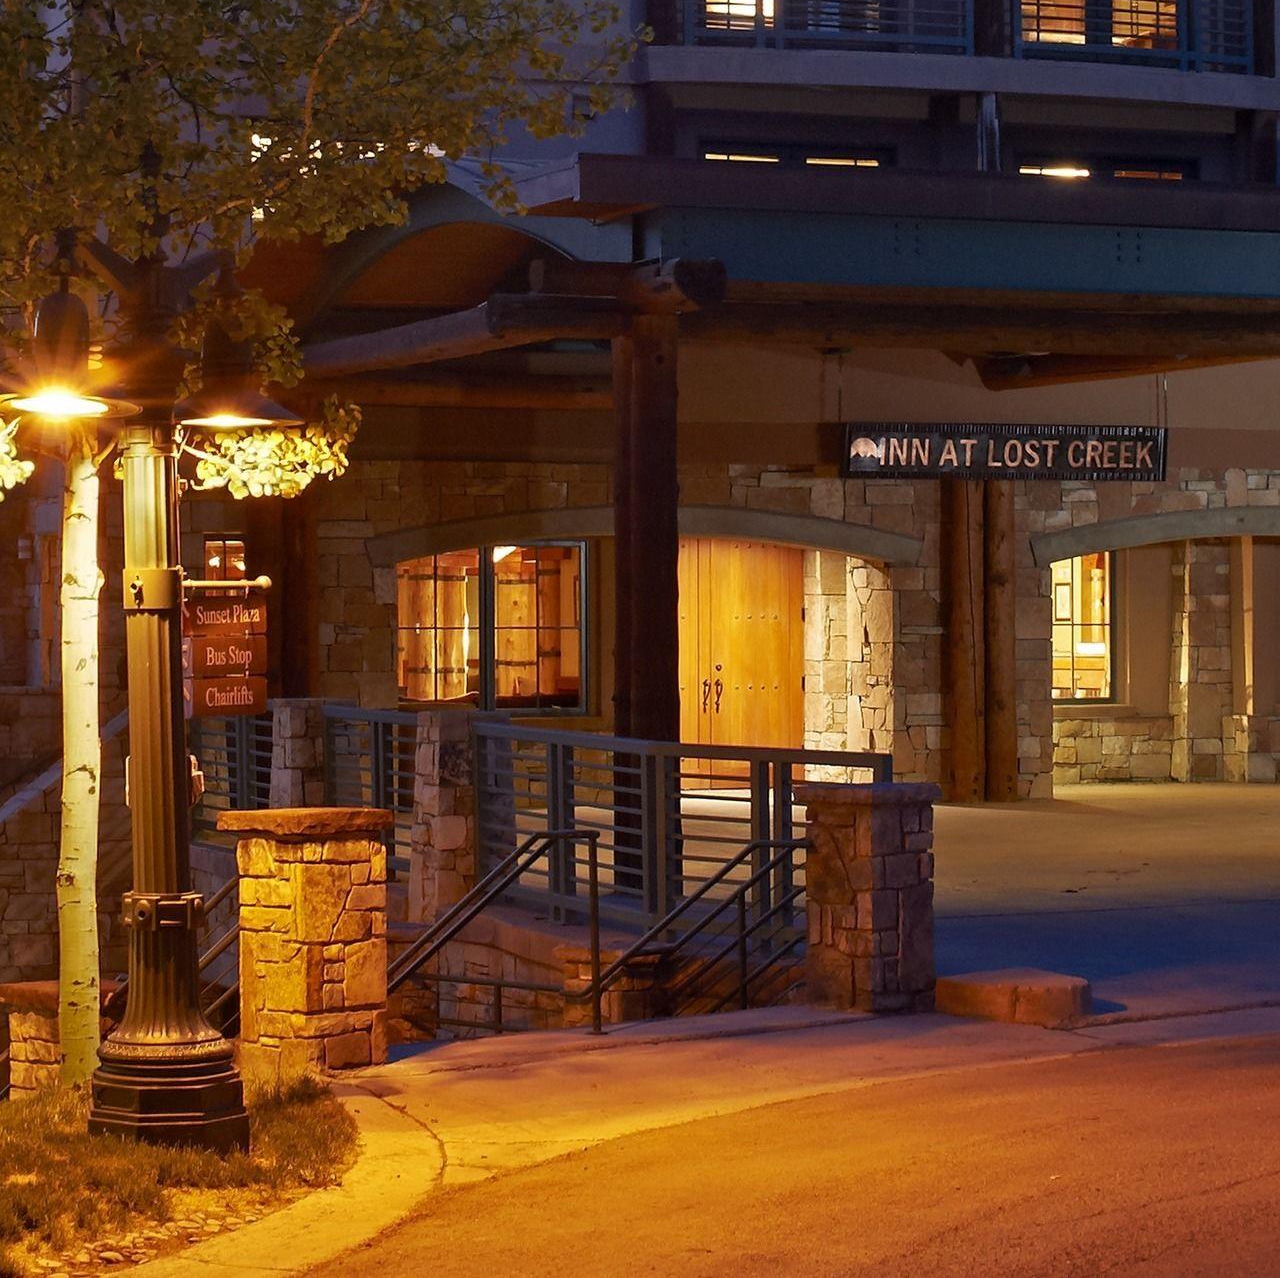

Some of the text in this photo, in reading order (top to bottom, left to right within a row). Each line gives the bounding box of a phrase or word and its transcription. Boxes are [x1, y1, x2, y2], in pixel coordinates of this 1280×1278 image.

[878, 436, 1154, 470] INN AT LOST CREEK
[196, 604, 261, 625] Sunset Plaza
[205, 645, 253, 669] Bus Stop
[205, 685, 255, 708] Chairlifts
